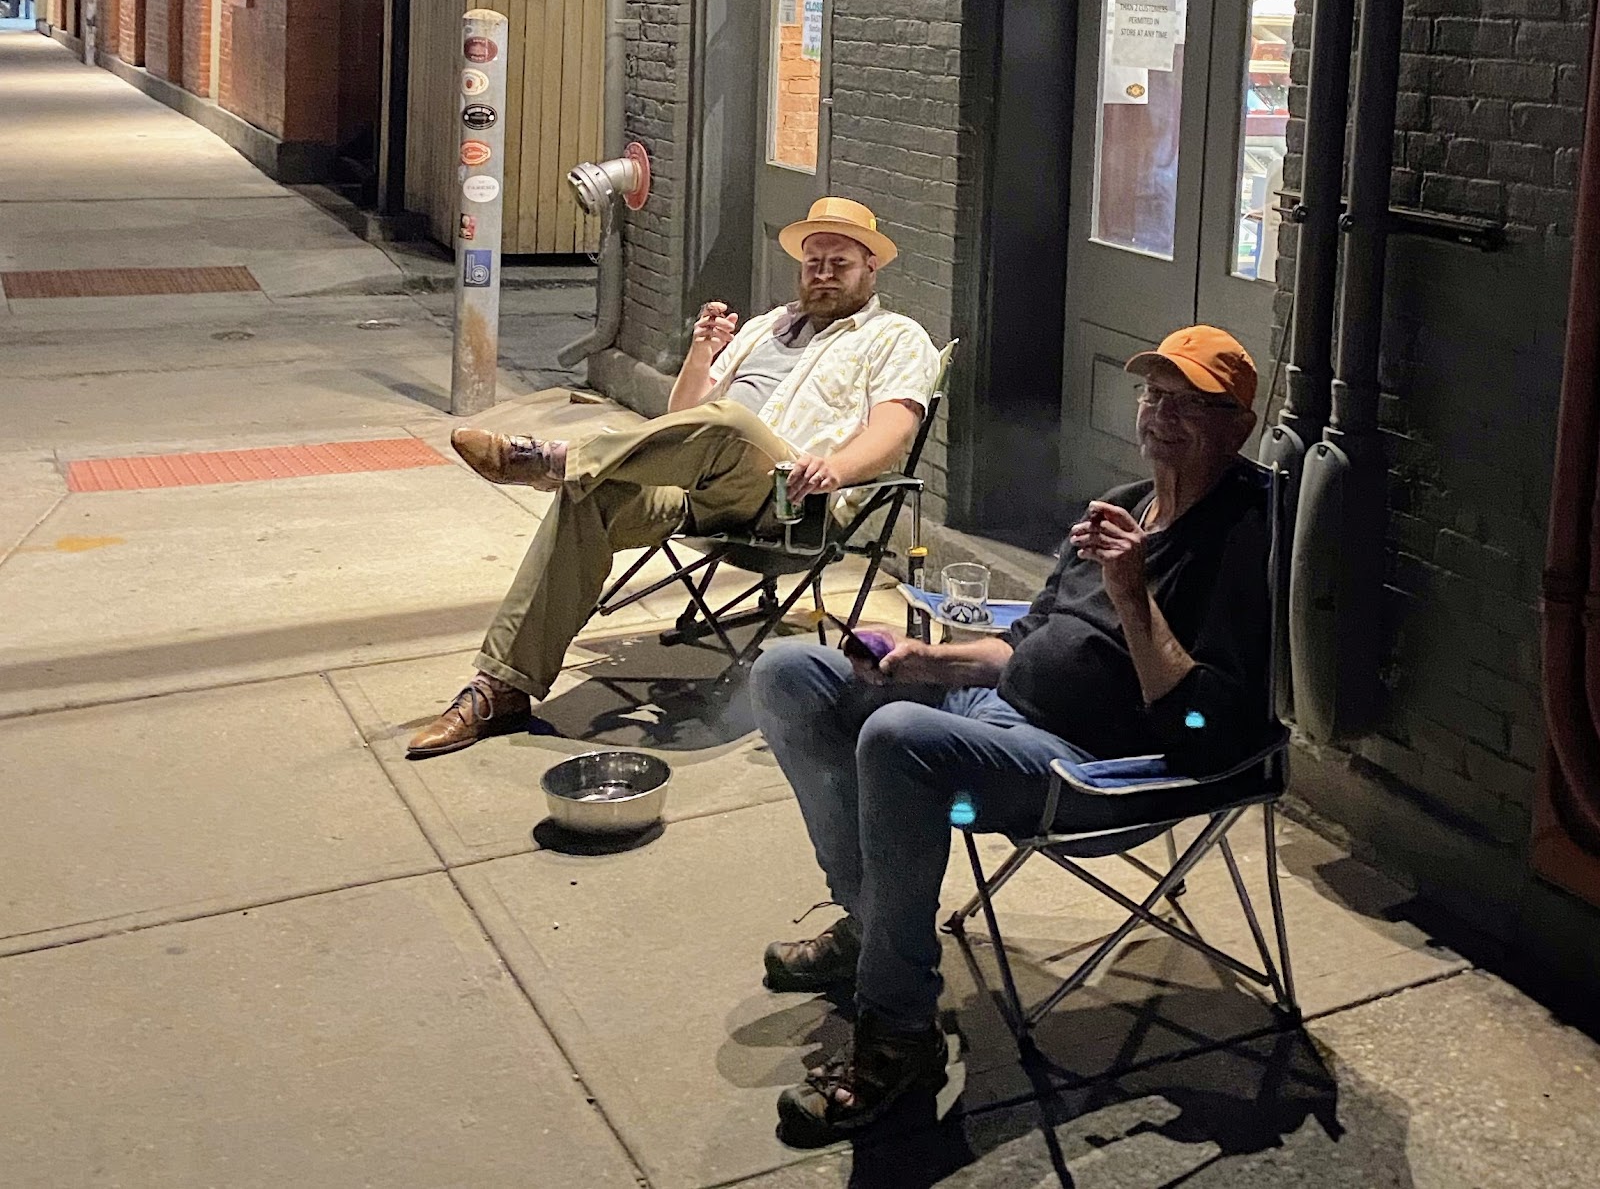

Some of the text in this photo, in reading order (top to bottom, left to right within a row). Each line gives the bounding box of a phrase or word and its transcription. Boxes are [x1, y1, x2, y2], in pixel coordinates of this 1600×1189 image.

[1139, 4, 1168, 13] CUSTOMERS
[1154, 17, 1160, 25] IN
[1137, 29, 1143, 37] AT
[1144, 30, 1154, 38] ANY
[1155, 30, 1168, 39] TIME
